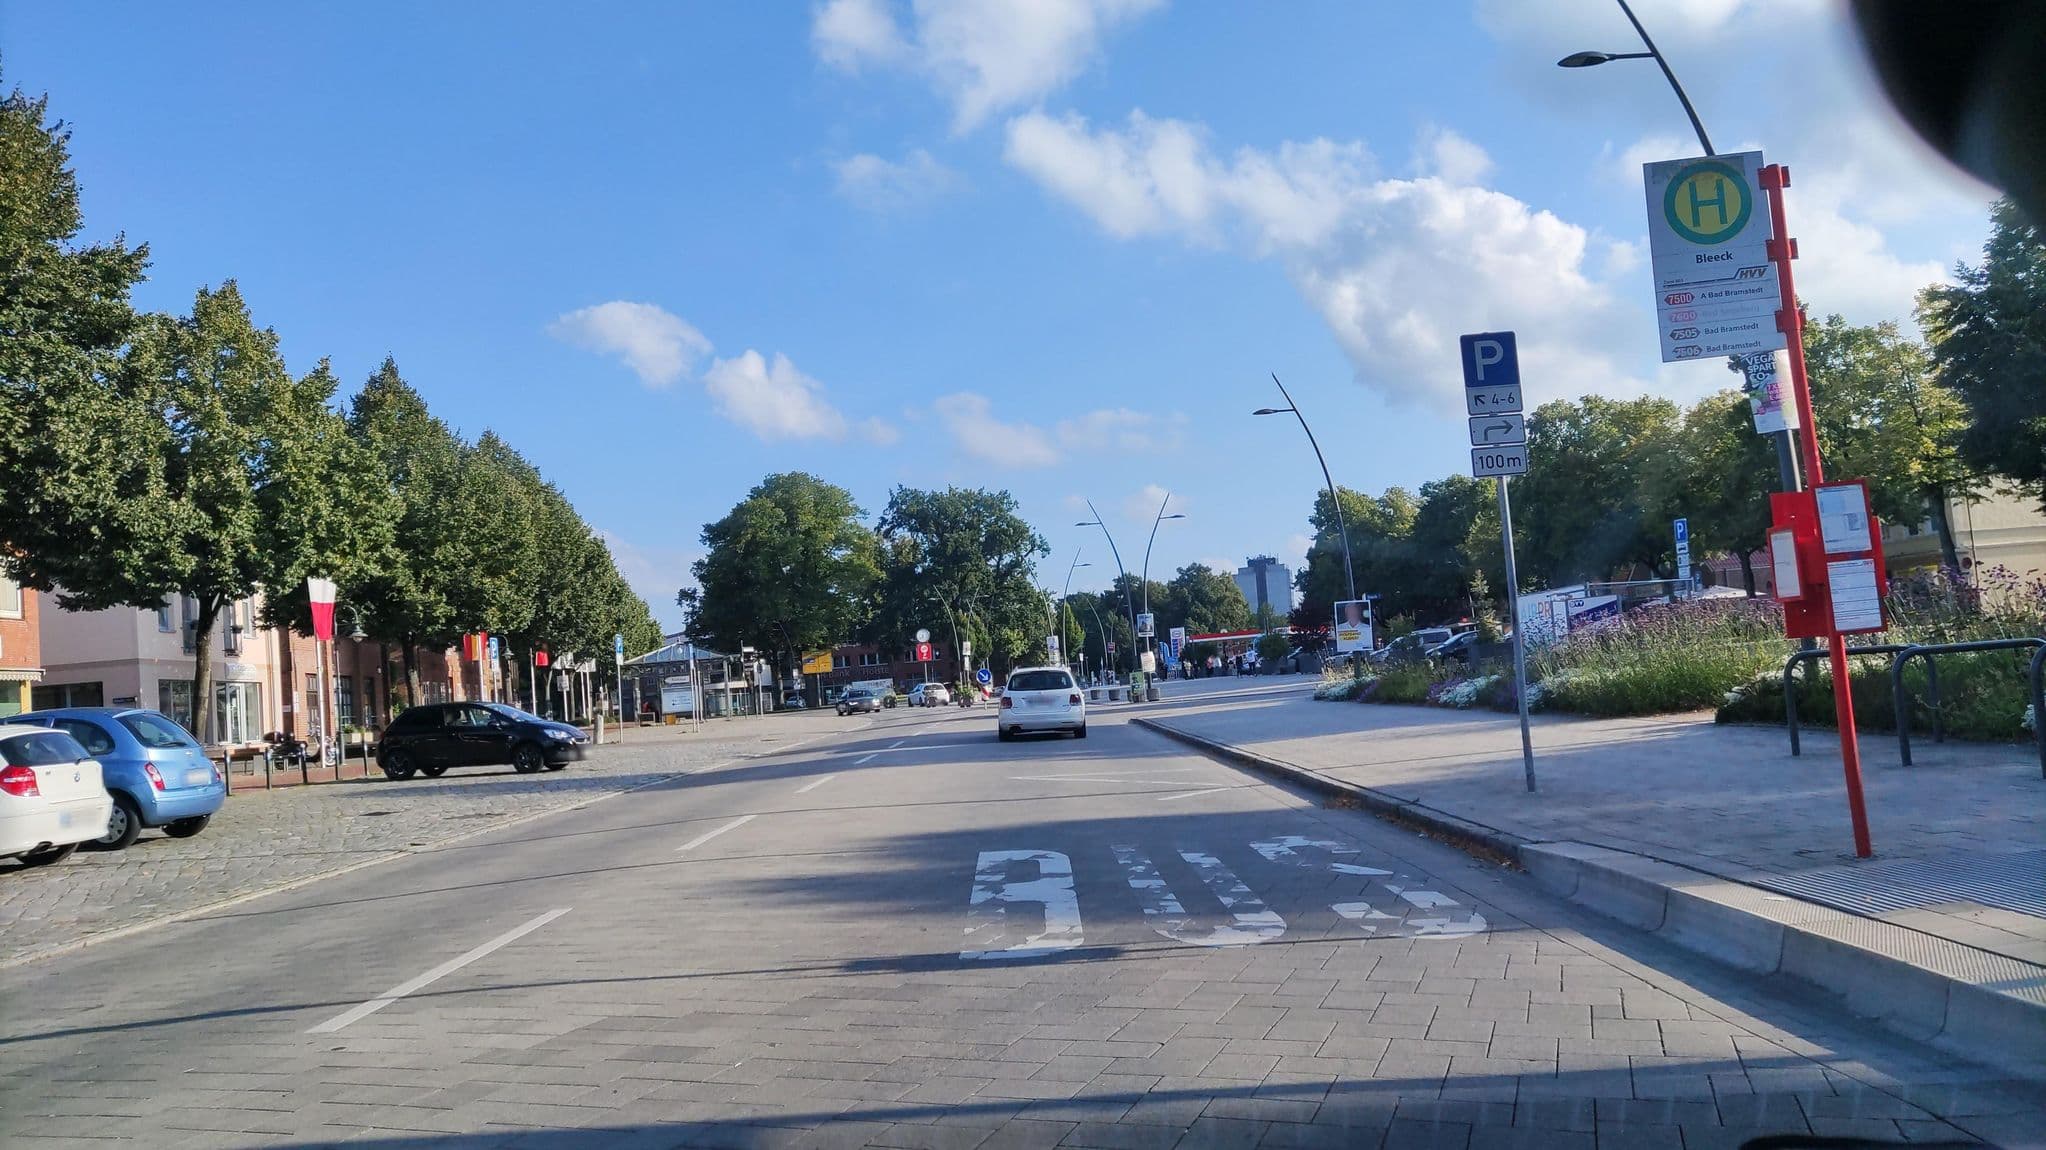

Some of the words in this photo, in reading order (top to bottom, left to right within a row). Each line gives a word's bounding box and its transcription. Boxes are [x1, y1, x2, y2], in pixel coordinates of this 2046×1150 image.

[1688, 178, 1728, 228] H
[1695, 251, 1734, 265] Bleeck
[1739, 268, 1767, 279] HVV
[1668, 294, 1692, 304] 7500
[1724, 287, 1764, 296] Bramstedt
[1673, 328, 1698, 339] 7505
[1704, 327, 1719, 335] Bad
[1720, 323, 1759, 333] Bramstedt
[1706, 345, 1721, 353] Bad
[1722, 341, 1761, 351] Bramstedt
[1473, 340, 1504, 381] P
[1746, 351, 1778, 366] VEGA
[1491, 391, 1515, 406] 4-6
[1676, 522, 1684, 540] P
[959, 835, 1488, 960] BUS
